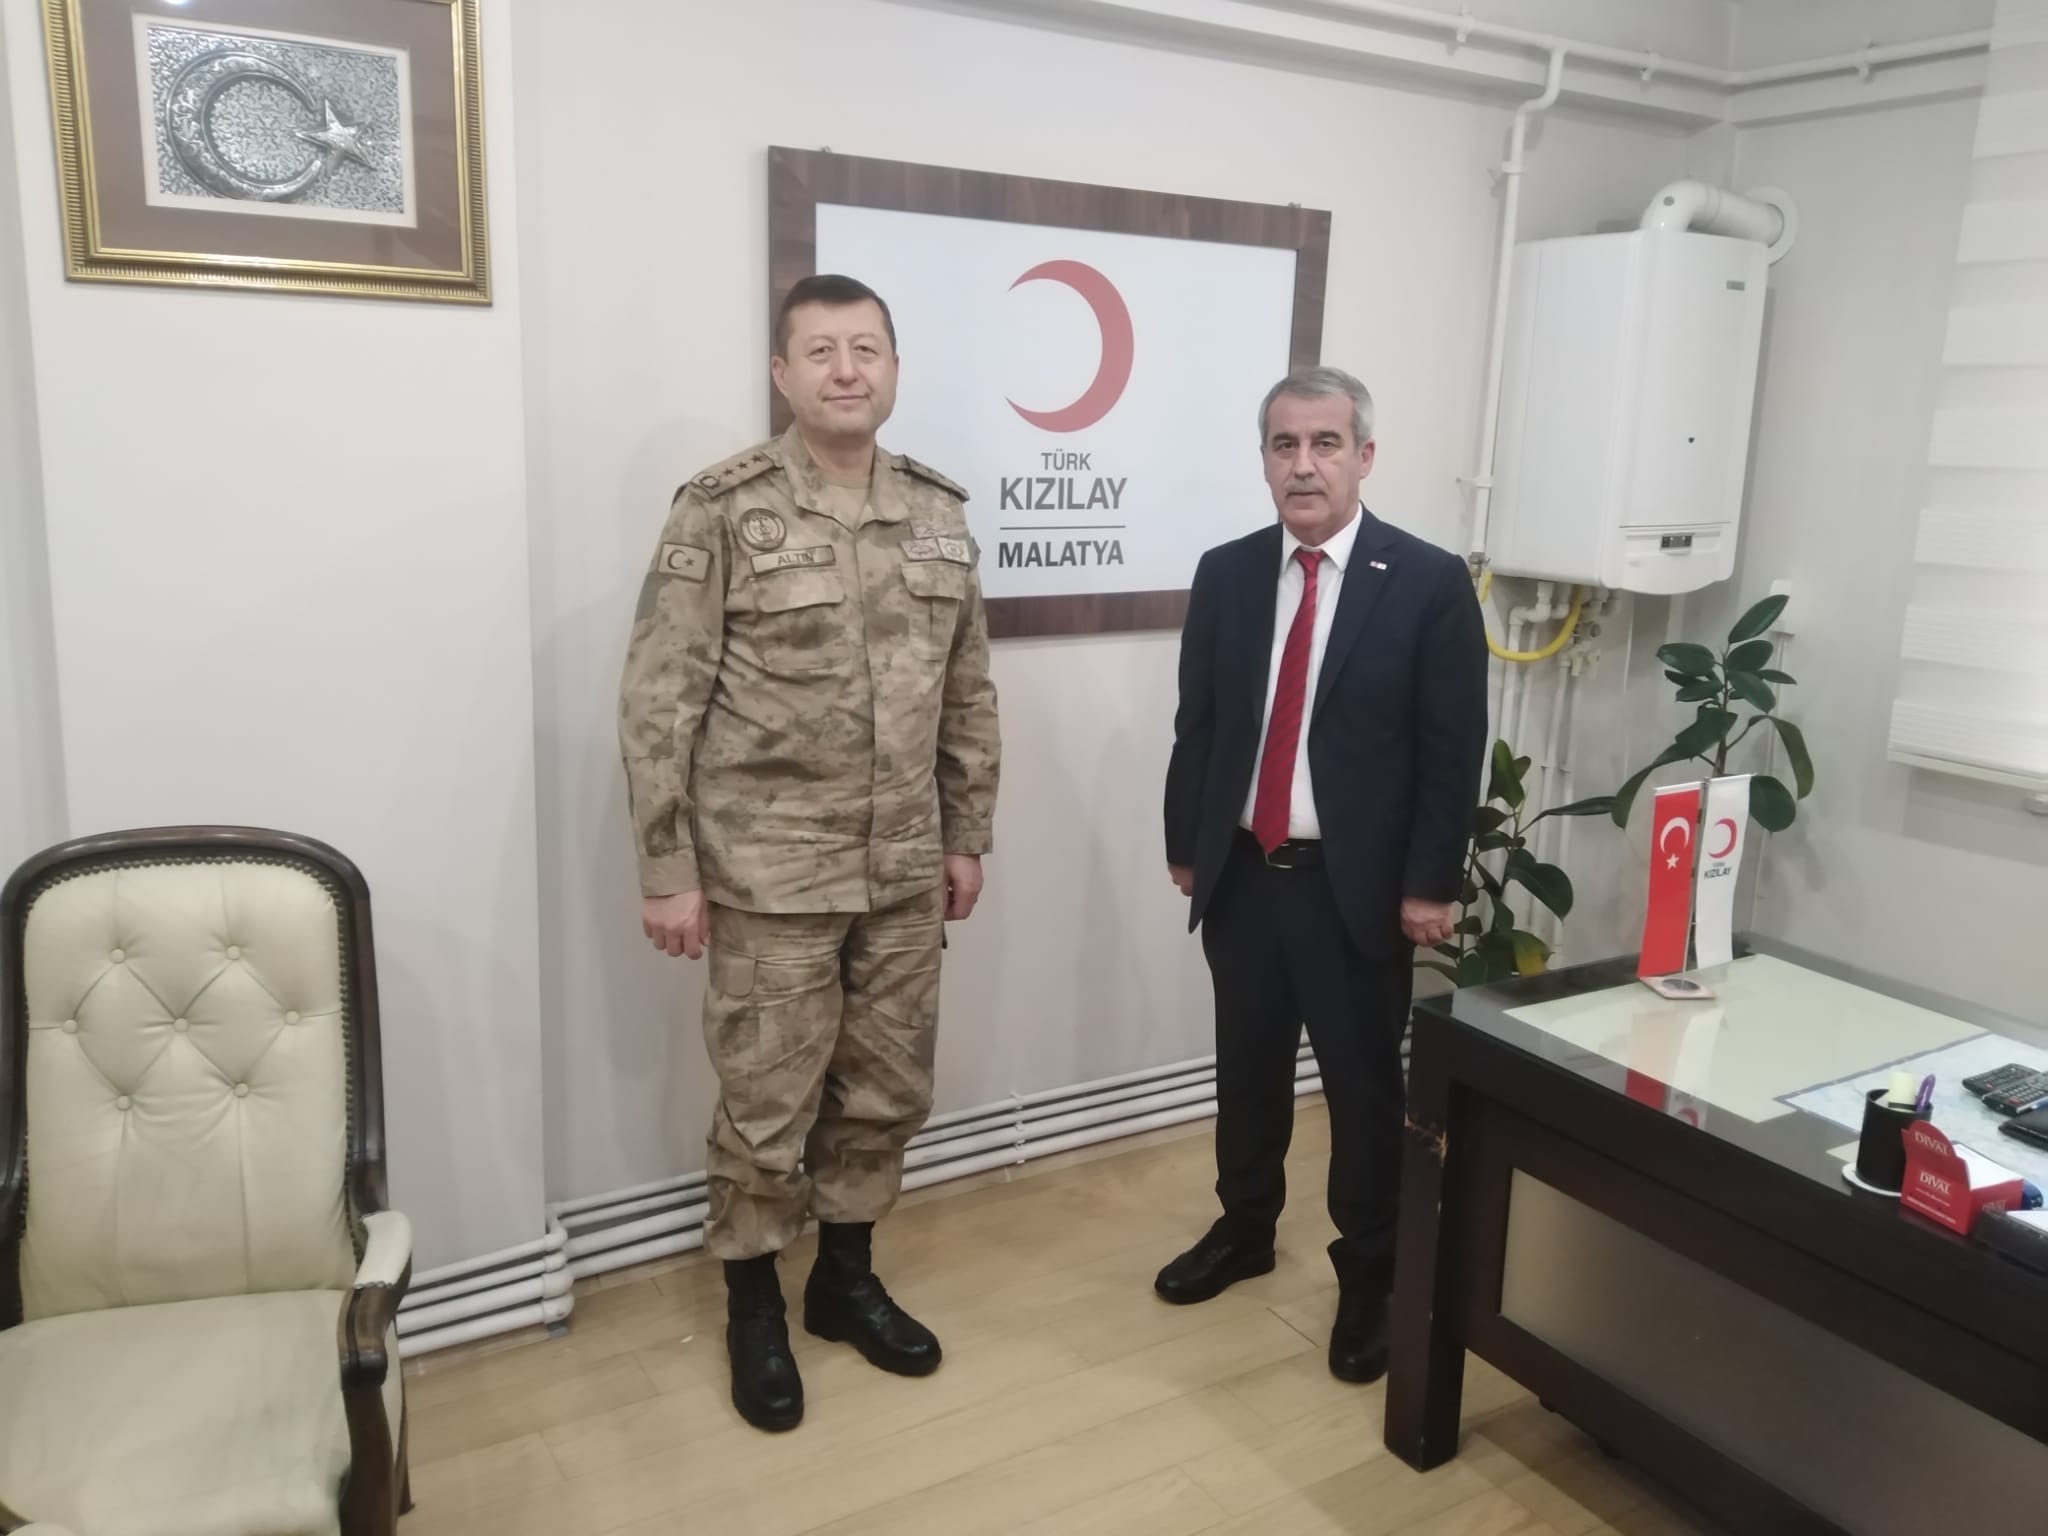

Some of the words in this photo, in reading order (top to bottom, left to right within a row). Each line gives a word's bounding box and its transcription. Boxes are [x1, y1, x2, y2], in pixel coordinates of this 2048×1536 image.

[1041, 448, 1091, 471] TÜRK
[1000, 477, 1127, 510] KIZILAY
[998, 540, 1124, 568] MALATYA
